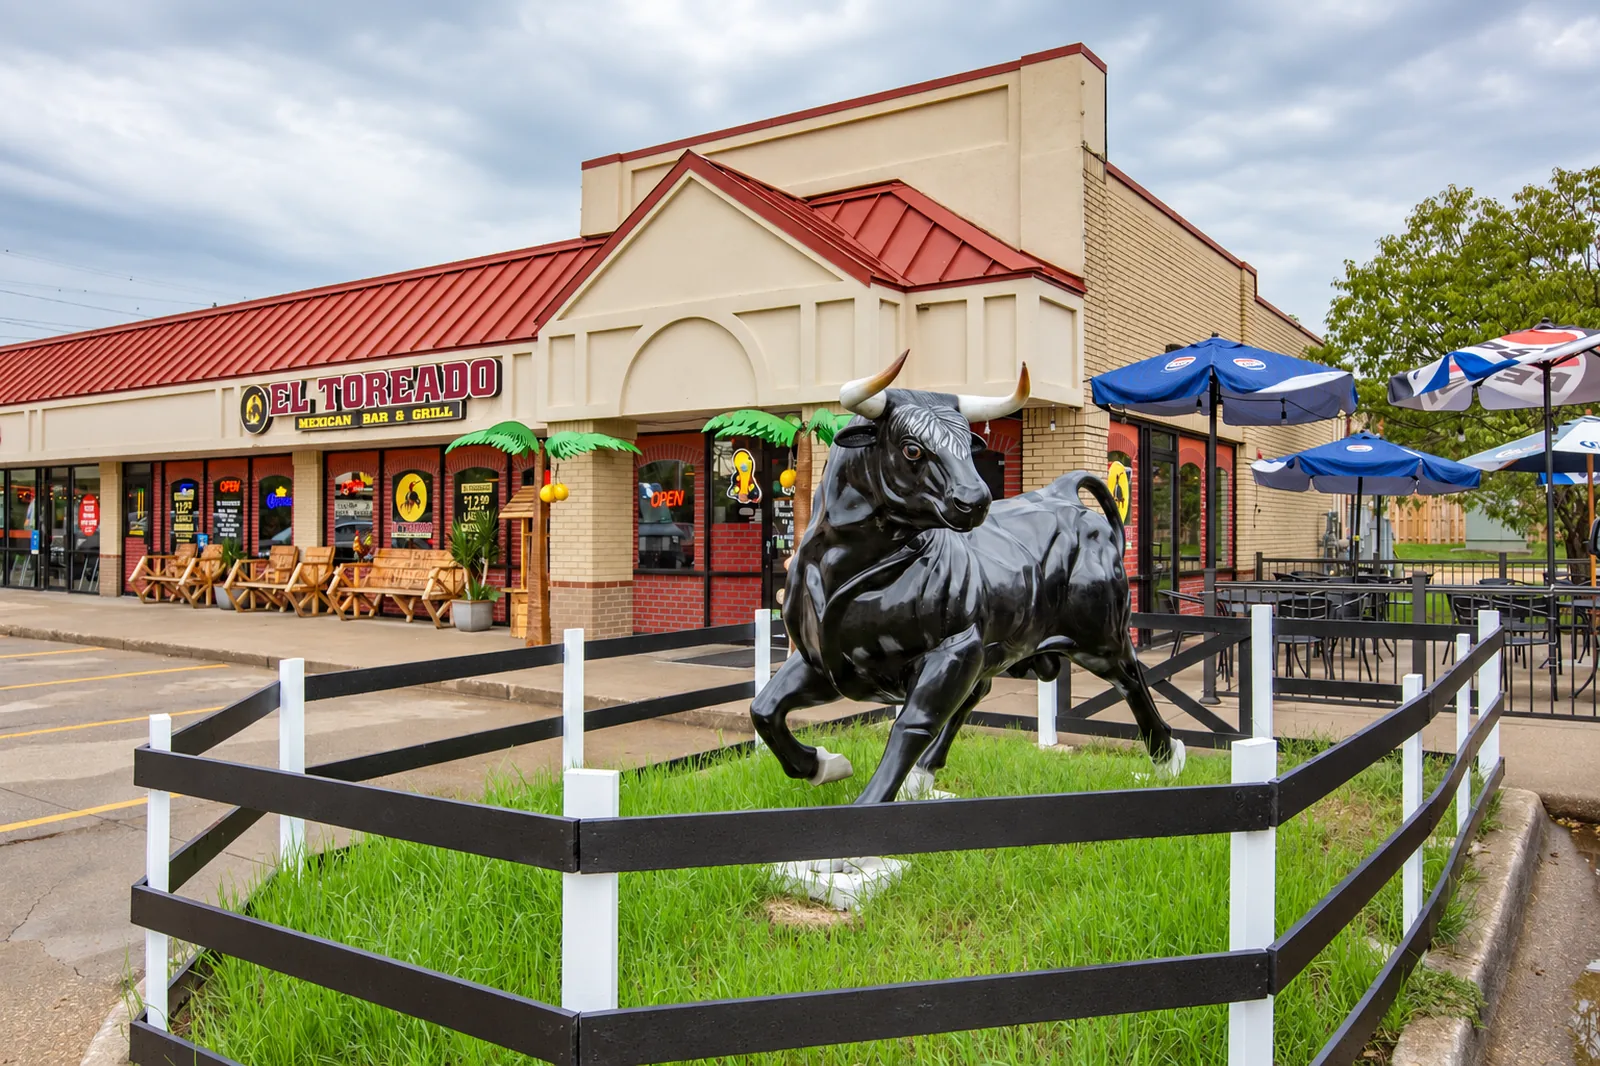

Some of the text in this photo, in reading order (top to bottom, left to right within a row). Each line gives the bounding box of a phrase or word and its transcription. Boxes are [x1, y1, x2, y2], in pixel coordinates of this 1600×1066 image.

[269, 357, 499, 417] EL TOREADO
[298, 406, 453, 429] MEXICAN BAR & GRILL
[220, 480, 240, 493] OPEN
[650, 489, 685, 508] OPEN
